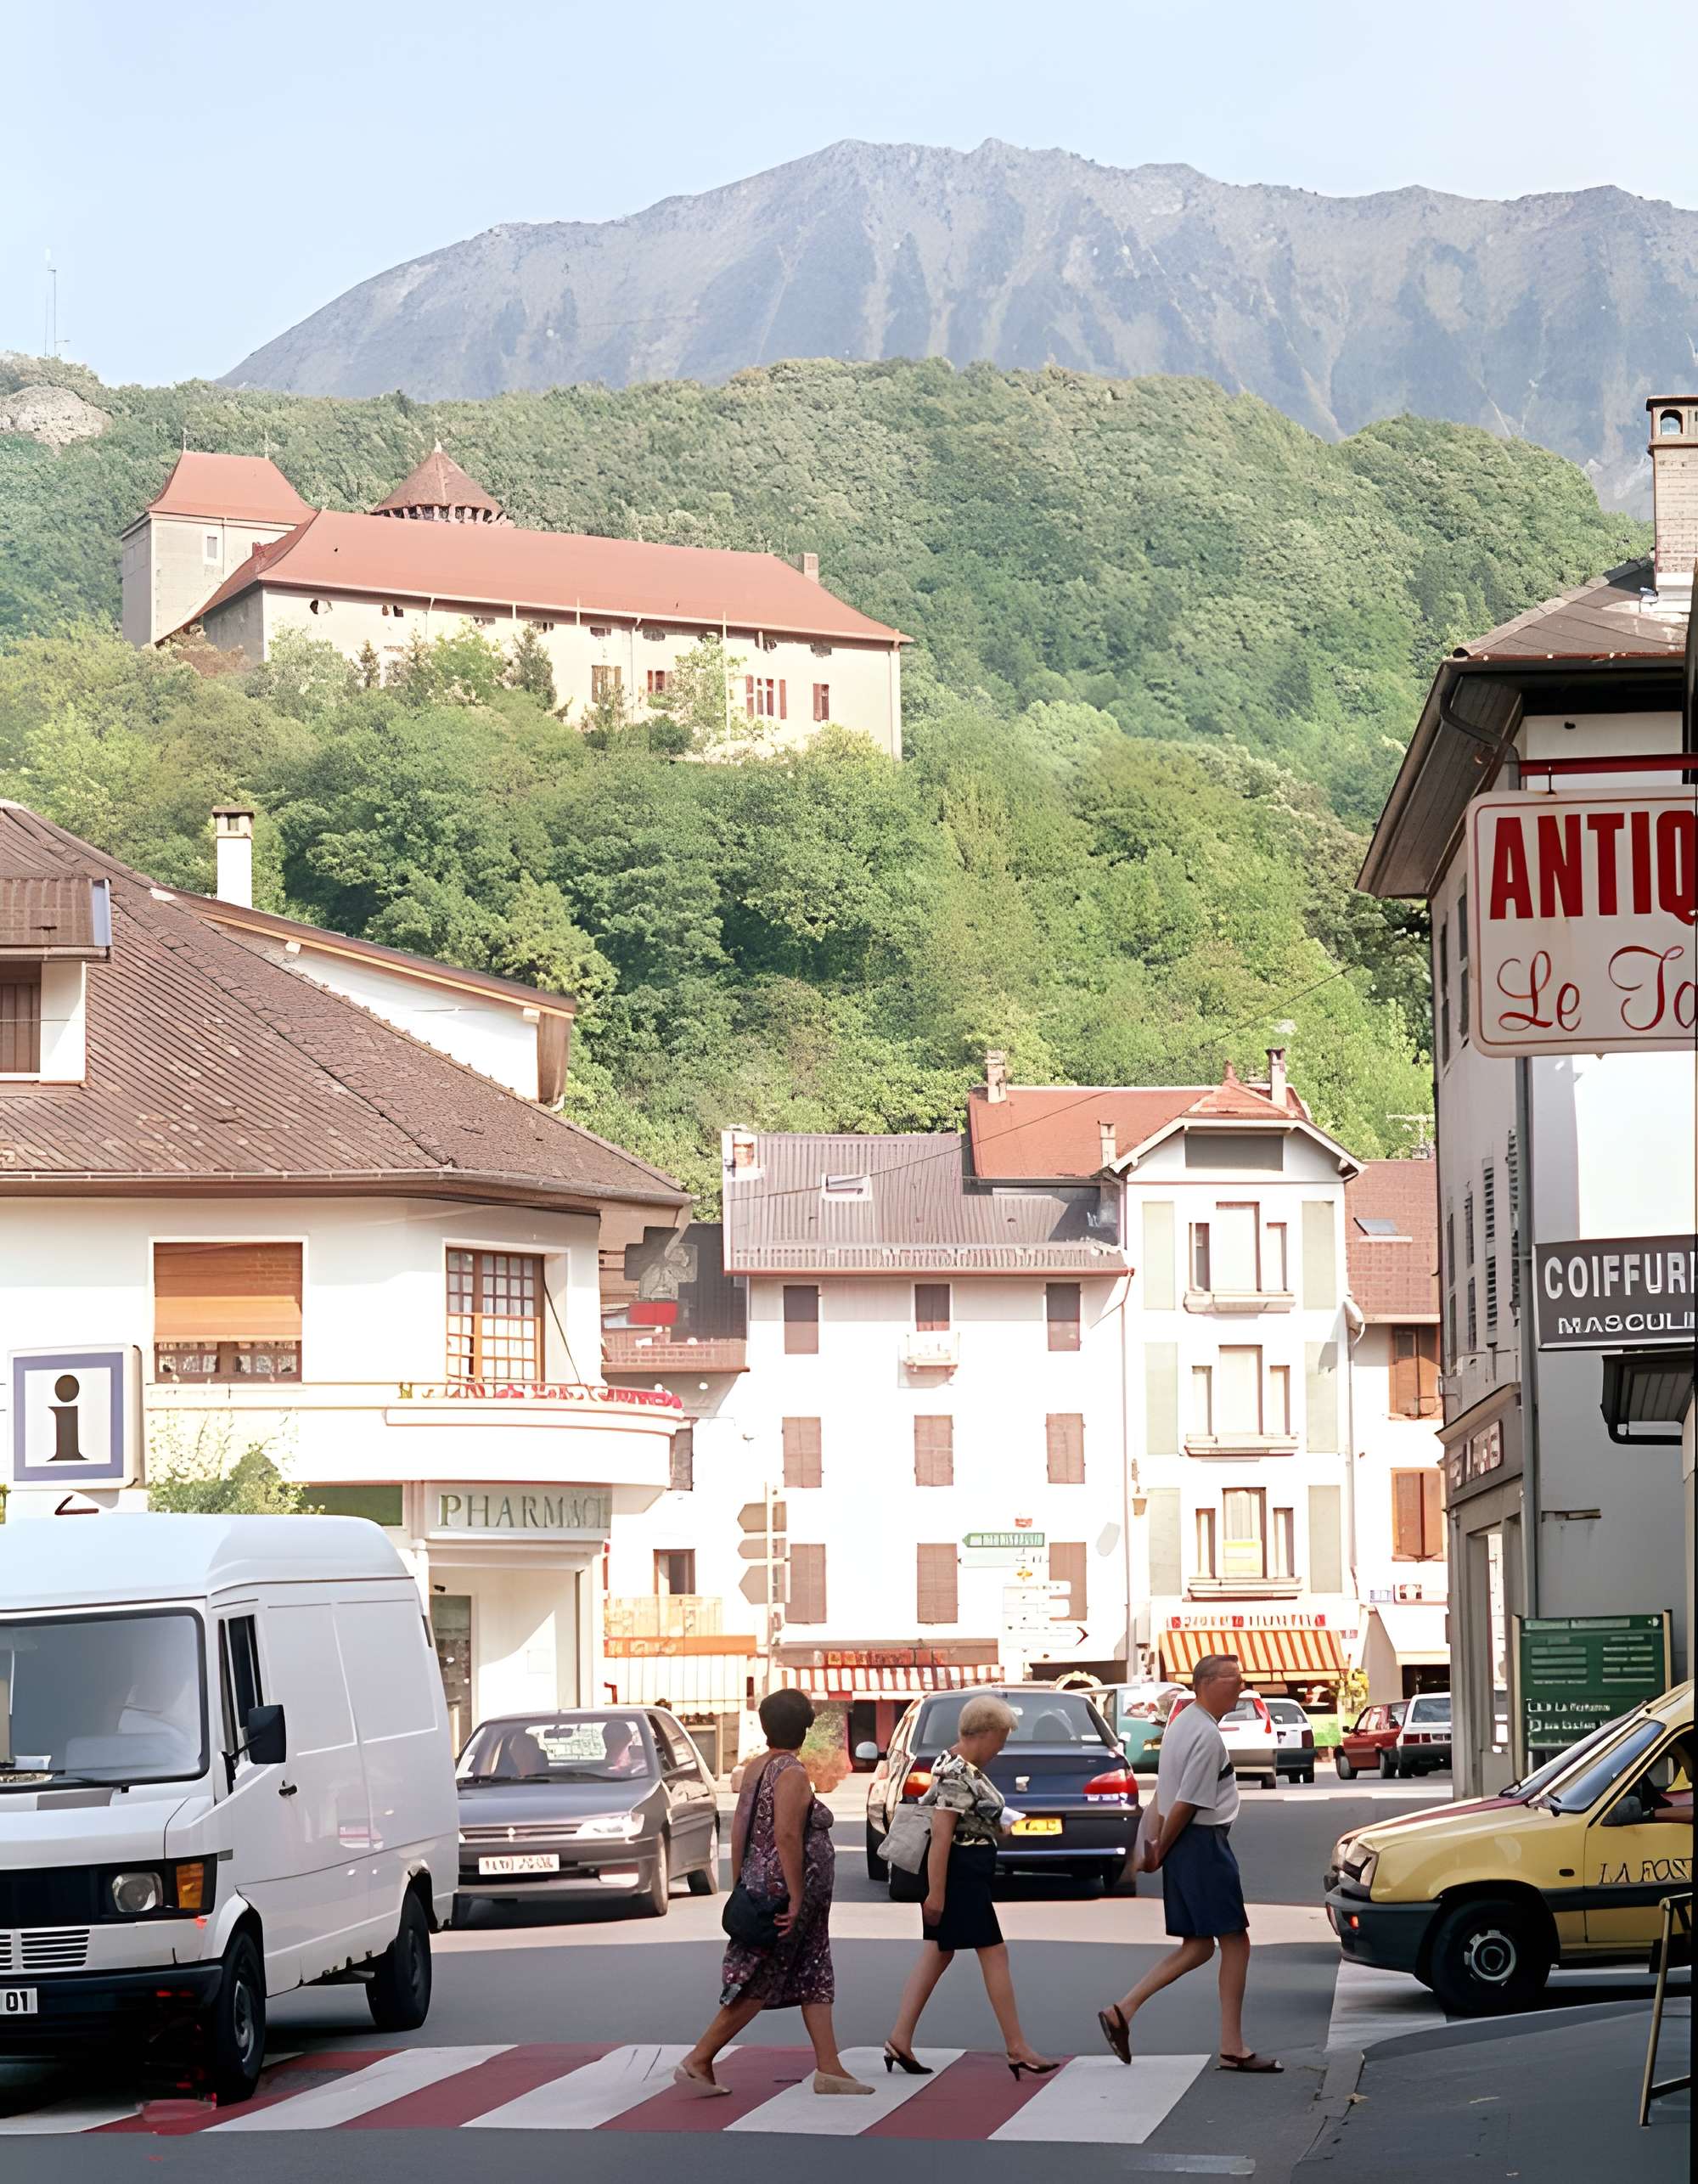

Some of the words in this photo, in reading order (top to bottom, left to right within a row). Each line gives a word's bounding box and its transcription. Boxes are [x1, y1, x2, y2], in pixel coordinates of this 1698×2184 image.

[1490, 810, 1696, 926] ANTIQ
[1497, 950, 1582, 1031] Le
[6, 1990, 28, 2012] 01
